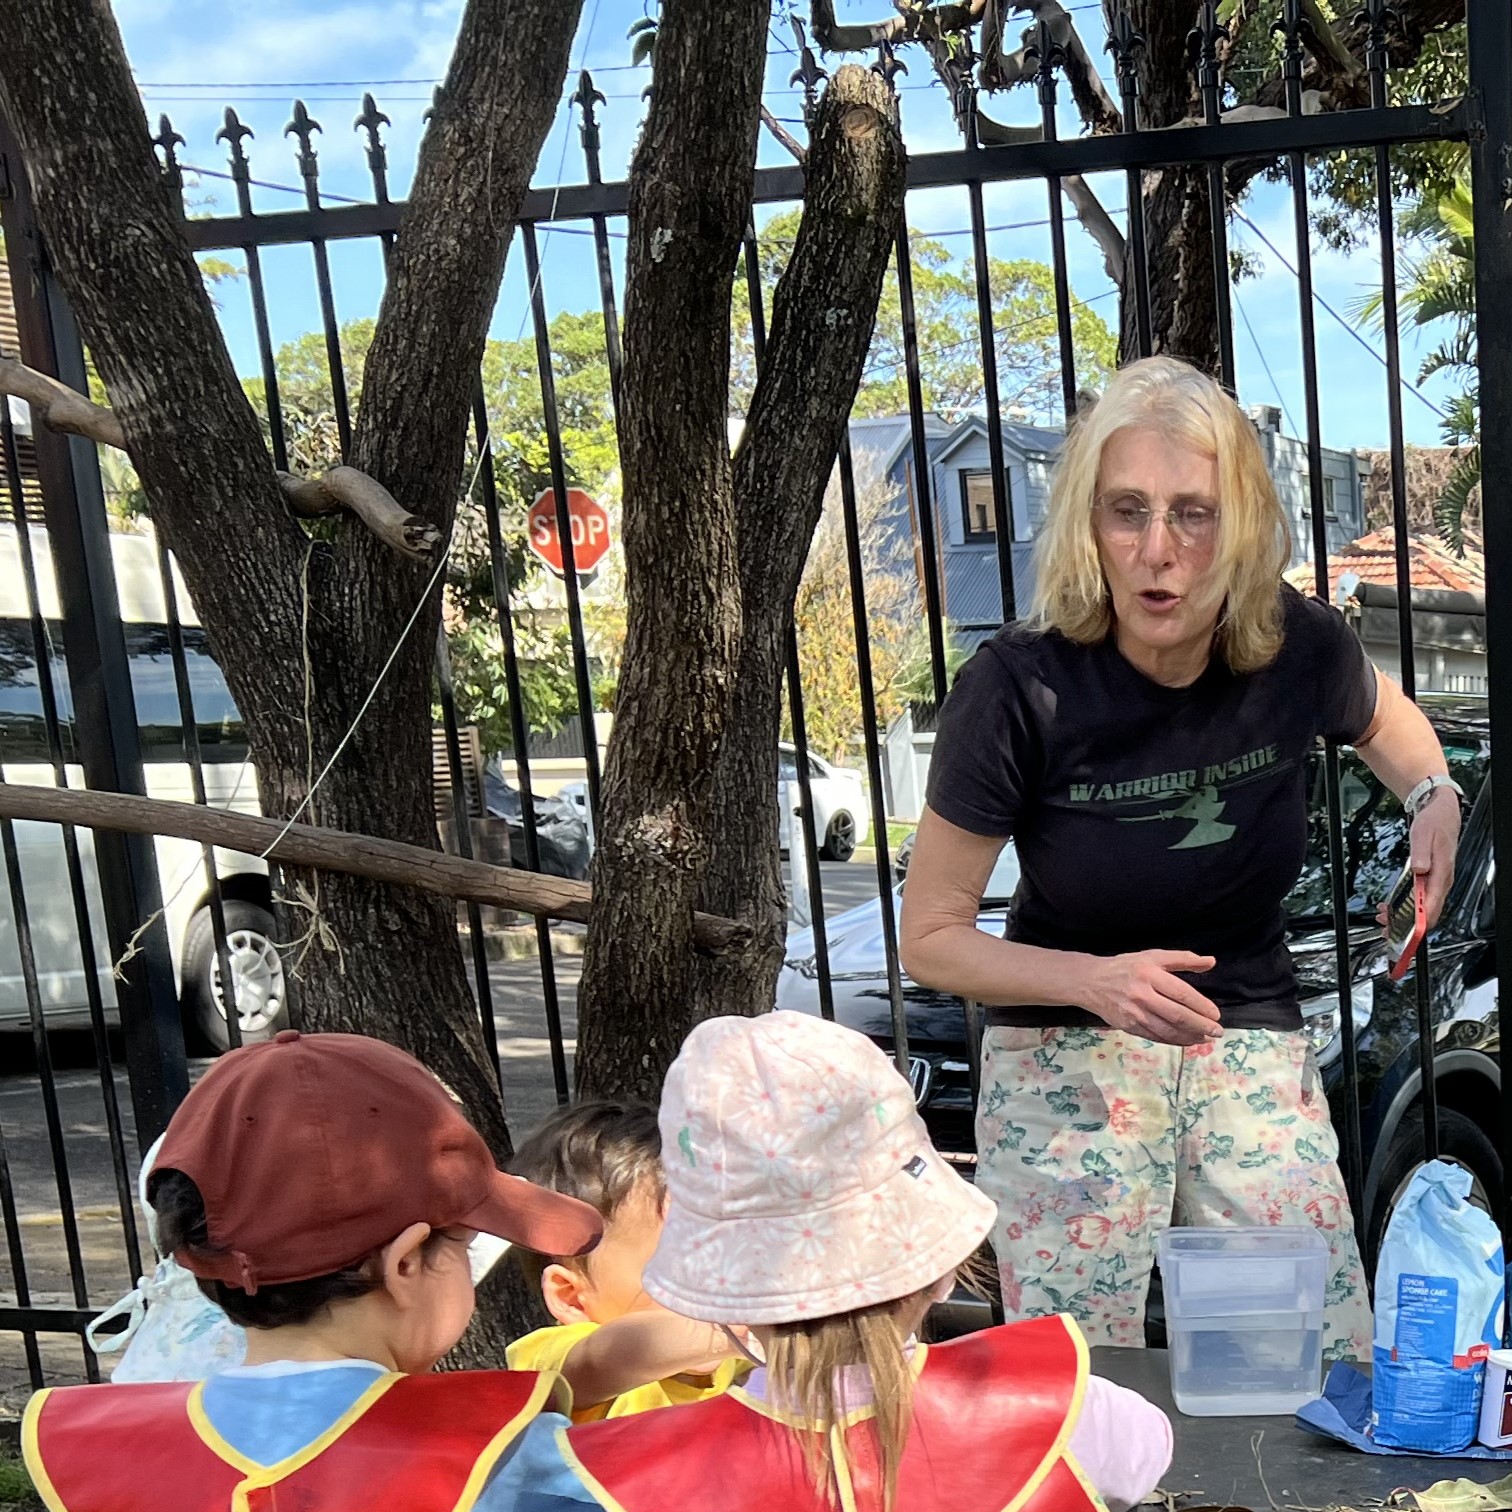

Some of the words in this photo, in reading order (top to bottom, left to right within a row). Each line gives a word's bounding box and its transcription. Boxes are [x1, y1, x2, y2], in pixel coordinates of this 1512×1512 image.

[533, 514, 604, 546] STOP
[1069, 769, 1197, 801] WARRIOR
[1203, 743, 1278, 784] INSIDE
[1430, 1289, 1448, 1297] CAKE
